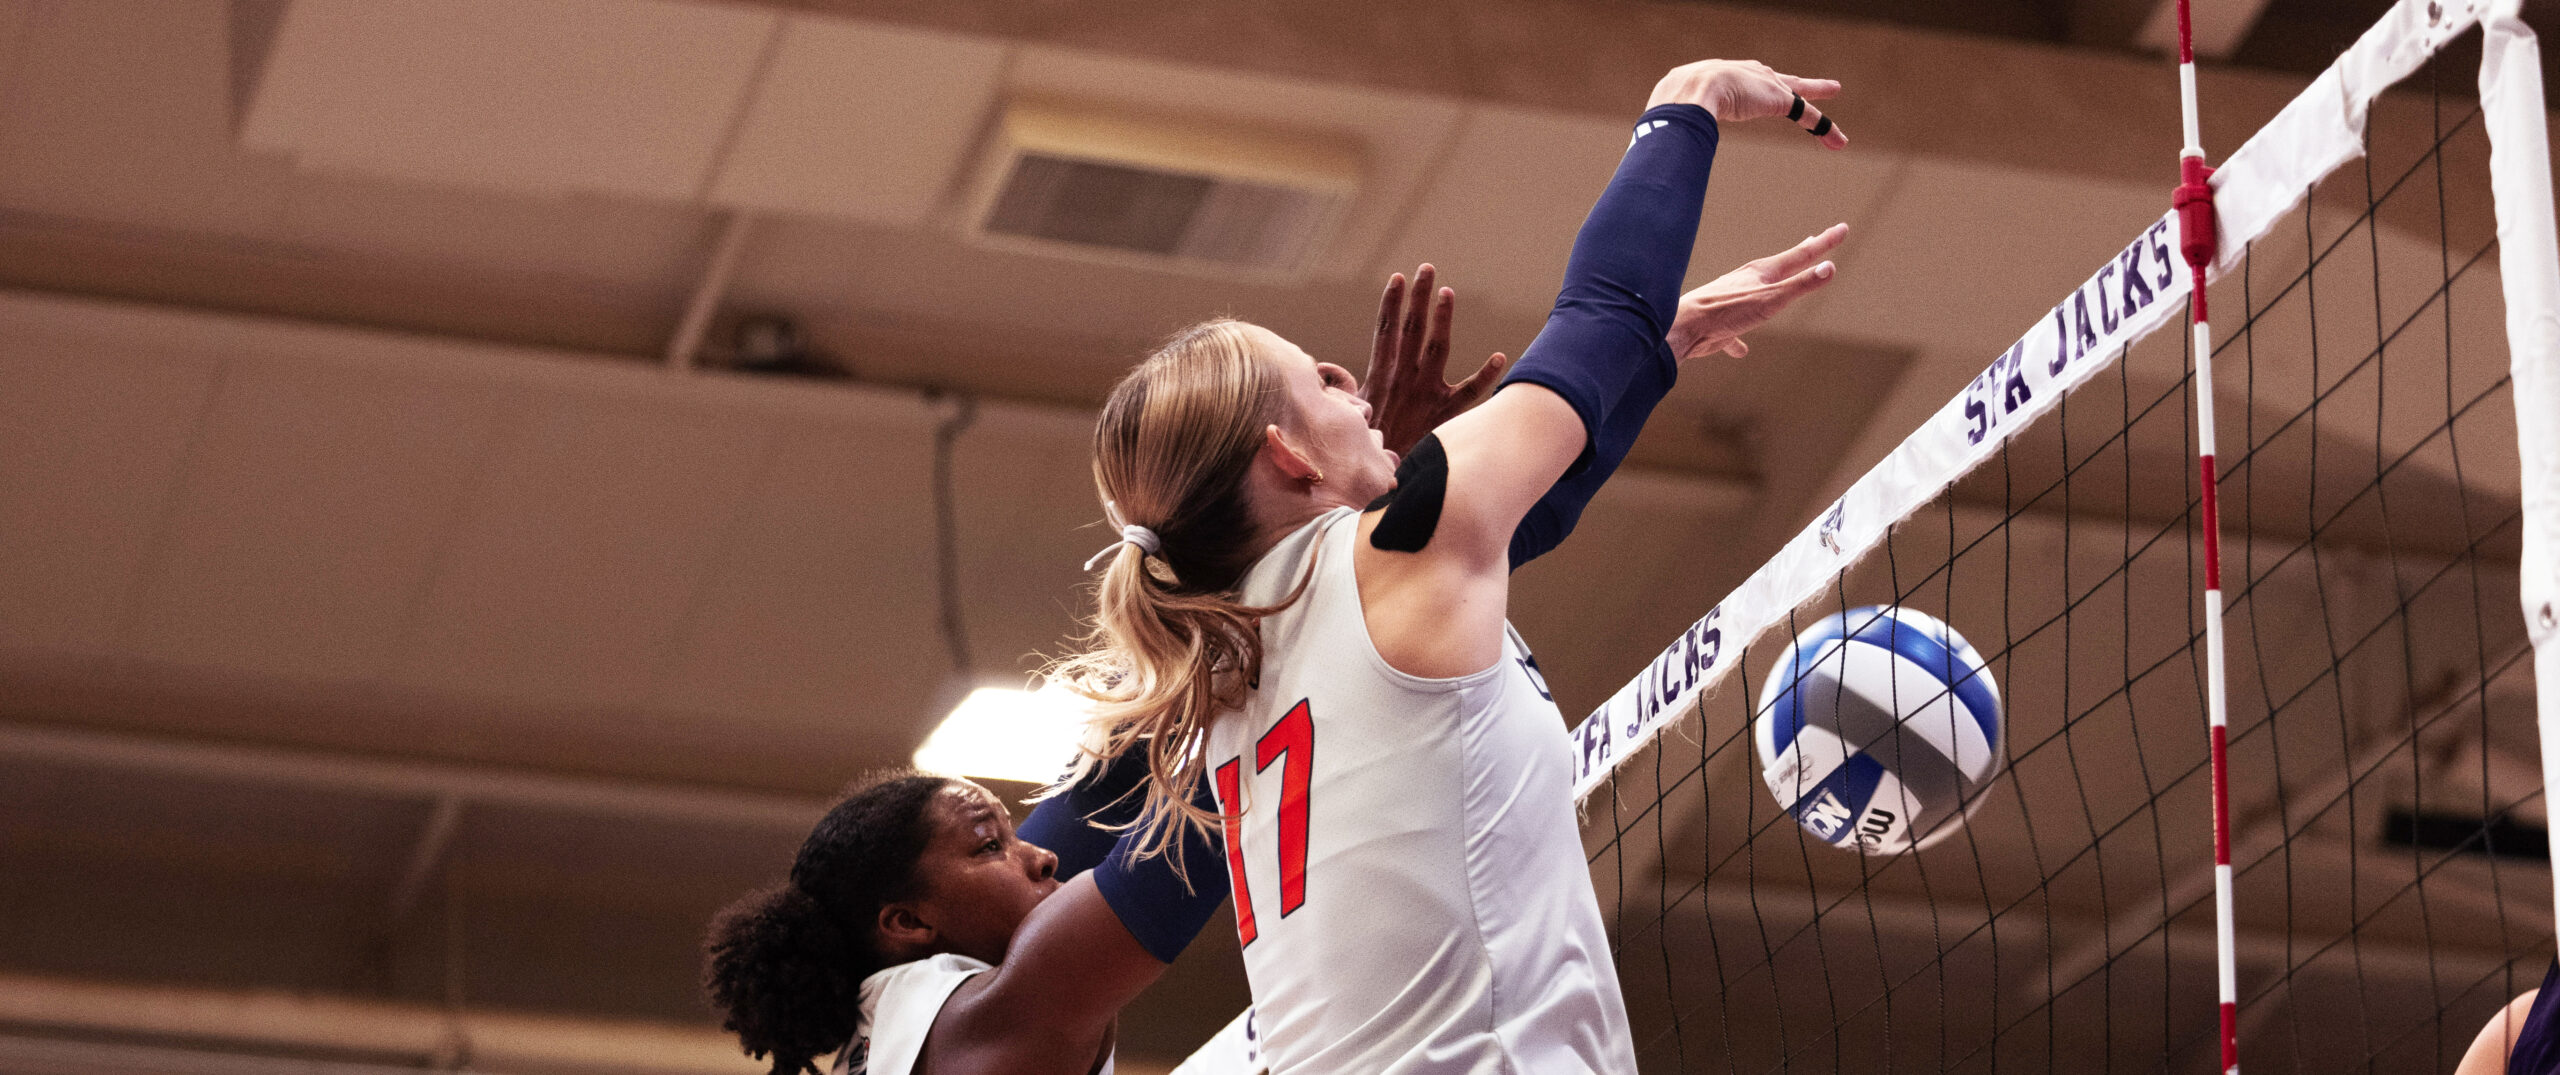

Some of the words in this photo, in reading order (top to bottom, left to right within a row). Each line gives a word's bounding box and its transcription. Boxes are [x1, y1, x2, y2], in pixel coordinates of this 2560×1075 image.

[1965, 338, 2032, 447] SFA
[2048, 217, 2173, 379] JACKS
[1626, 604, 1722, 739] JACKS
[1216, 697, 1314, 951] 17
